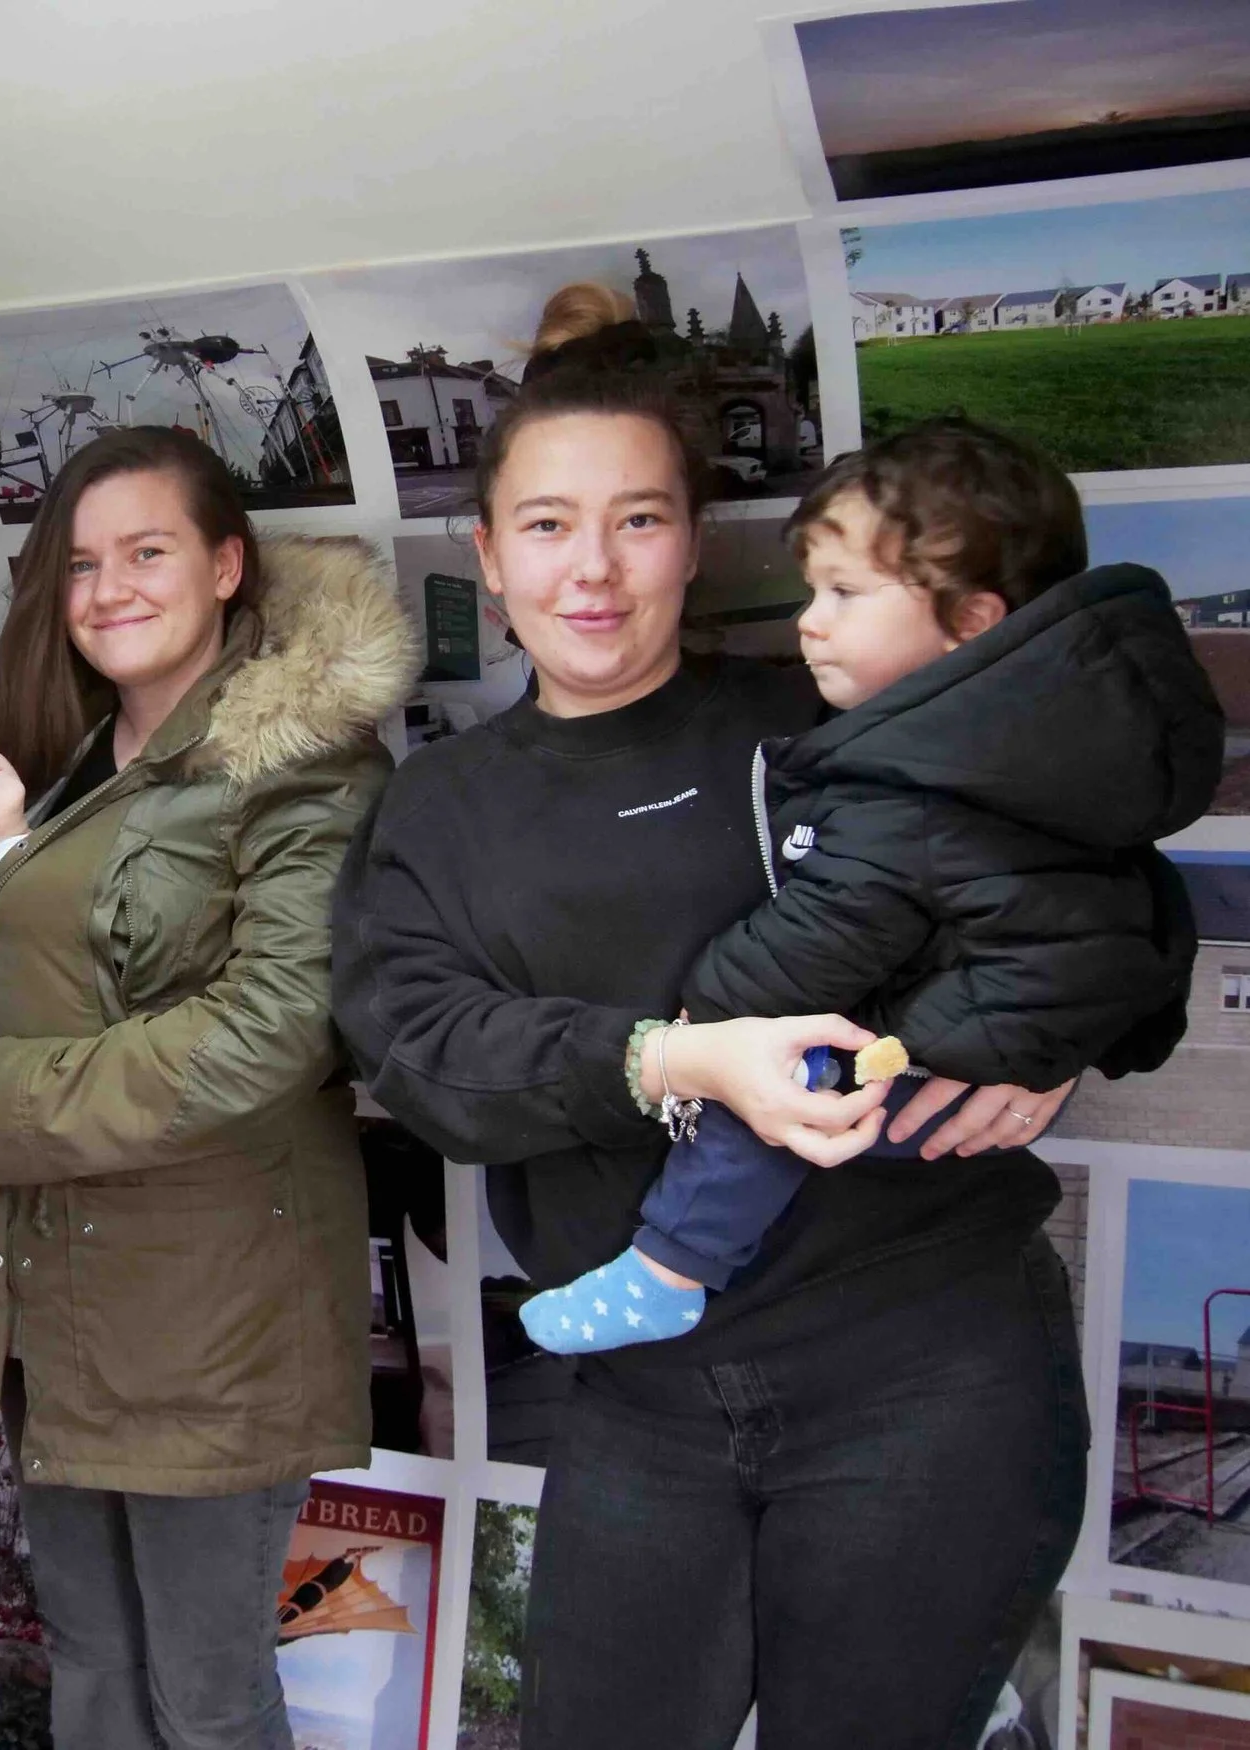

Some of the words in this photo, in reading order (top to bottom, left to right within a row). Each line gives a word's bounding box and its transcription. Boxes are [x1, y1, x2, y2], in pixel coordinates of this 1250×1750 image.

[617, 805, 648, 818] CALVIN
[648, 799, 673, 811] KLEIN
[672, 787, 699, 805] JEANS
[790, 824, 816, 847] NI
